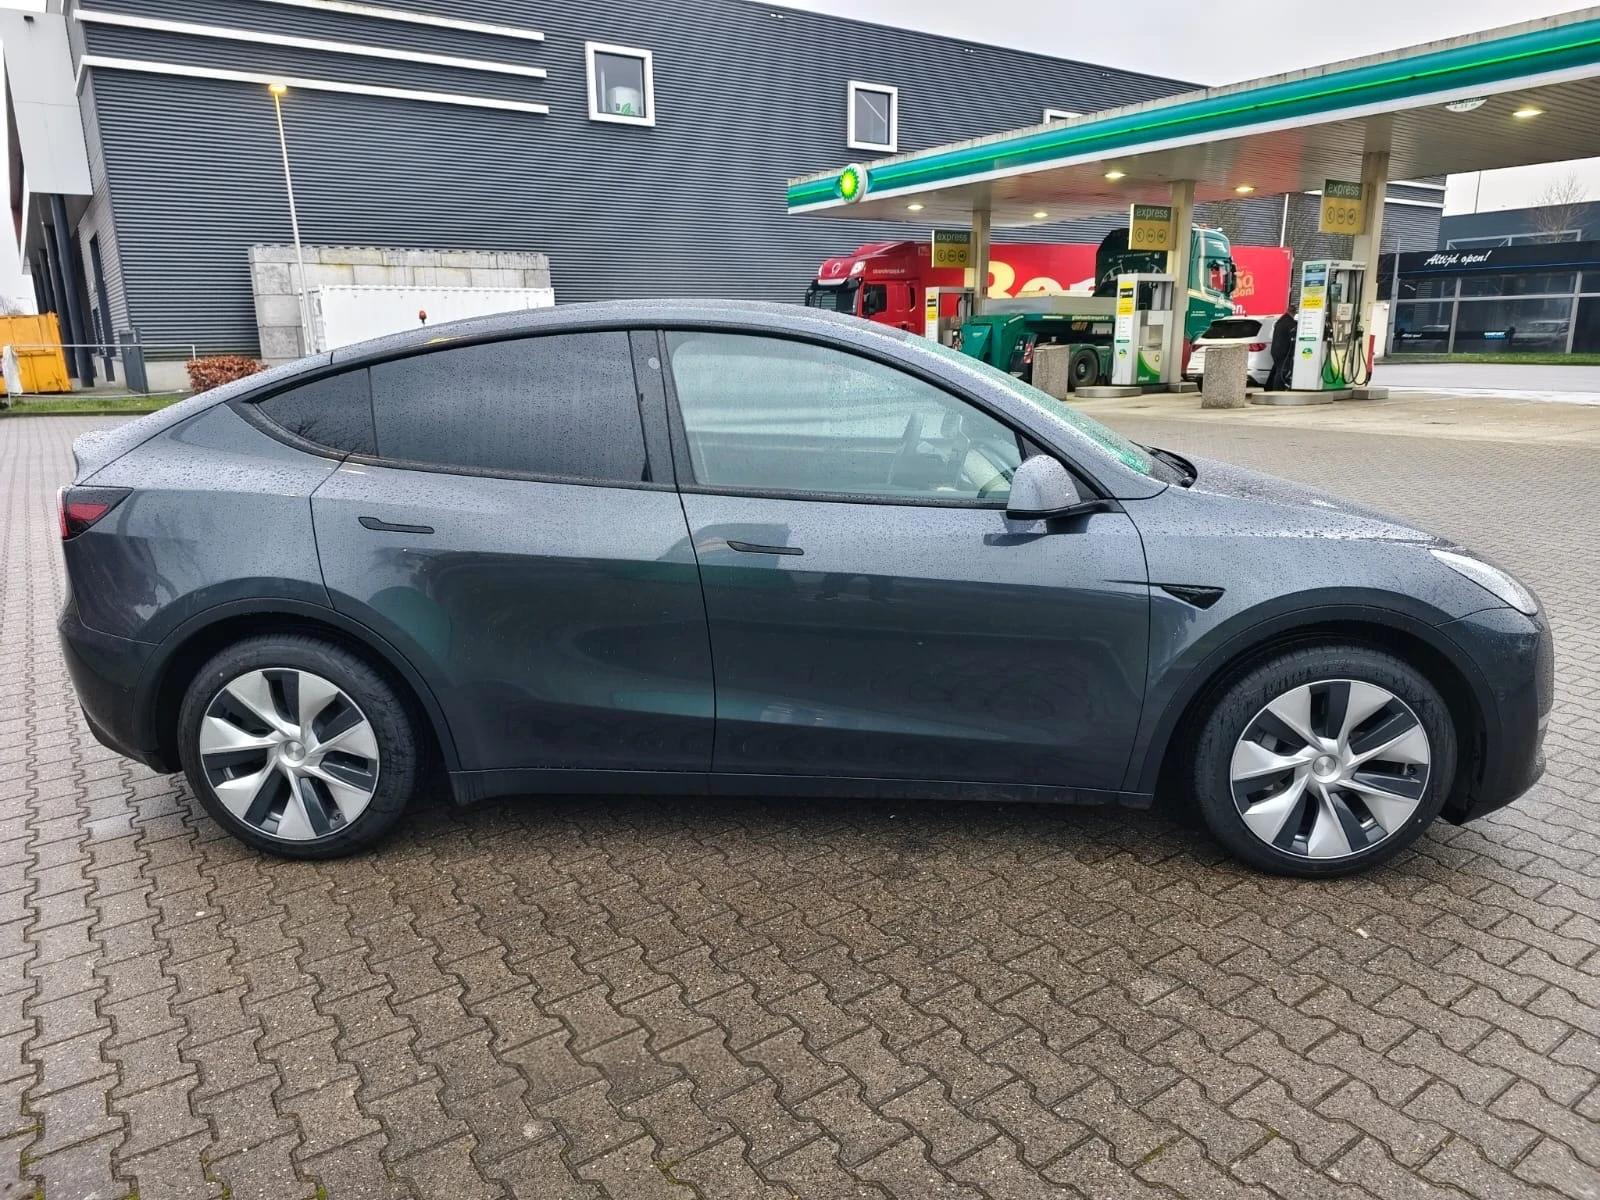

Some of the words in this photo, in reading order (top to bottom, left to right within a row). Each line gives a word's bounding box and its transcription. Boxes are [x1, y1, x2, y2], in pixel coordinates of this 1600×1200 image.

[1327, 183, 1359, 196] express
[1136, 207, 1168, 219] express
[936, 232, 968, 243] express
[1424, 253, 1460, 267] Altijd
[1461, 250, 1492, 265] open!
